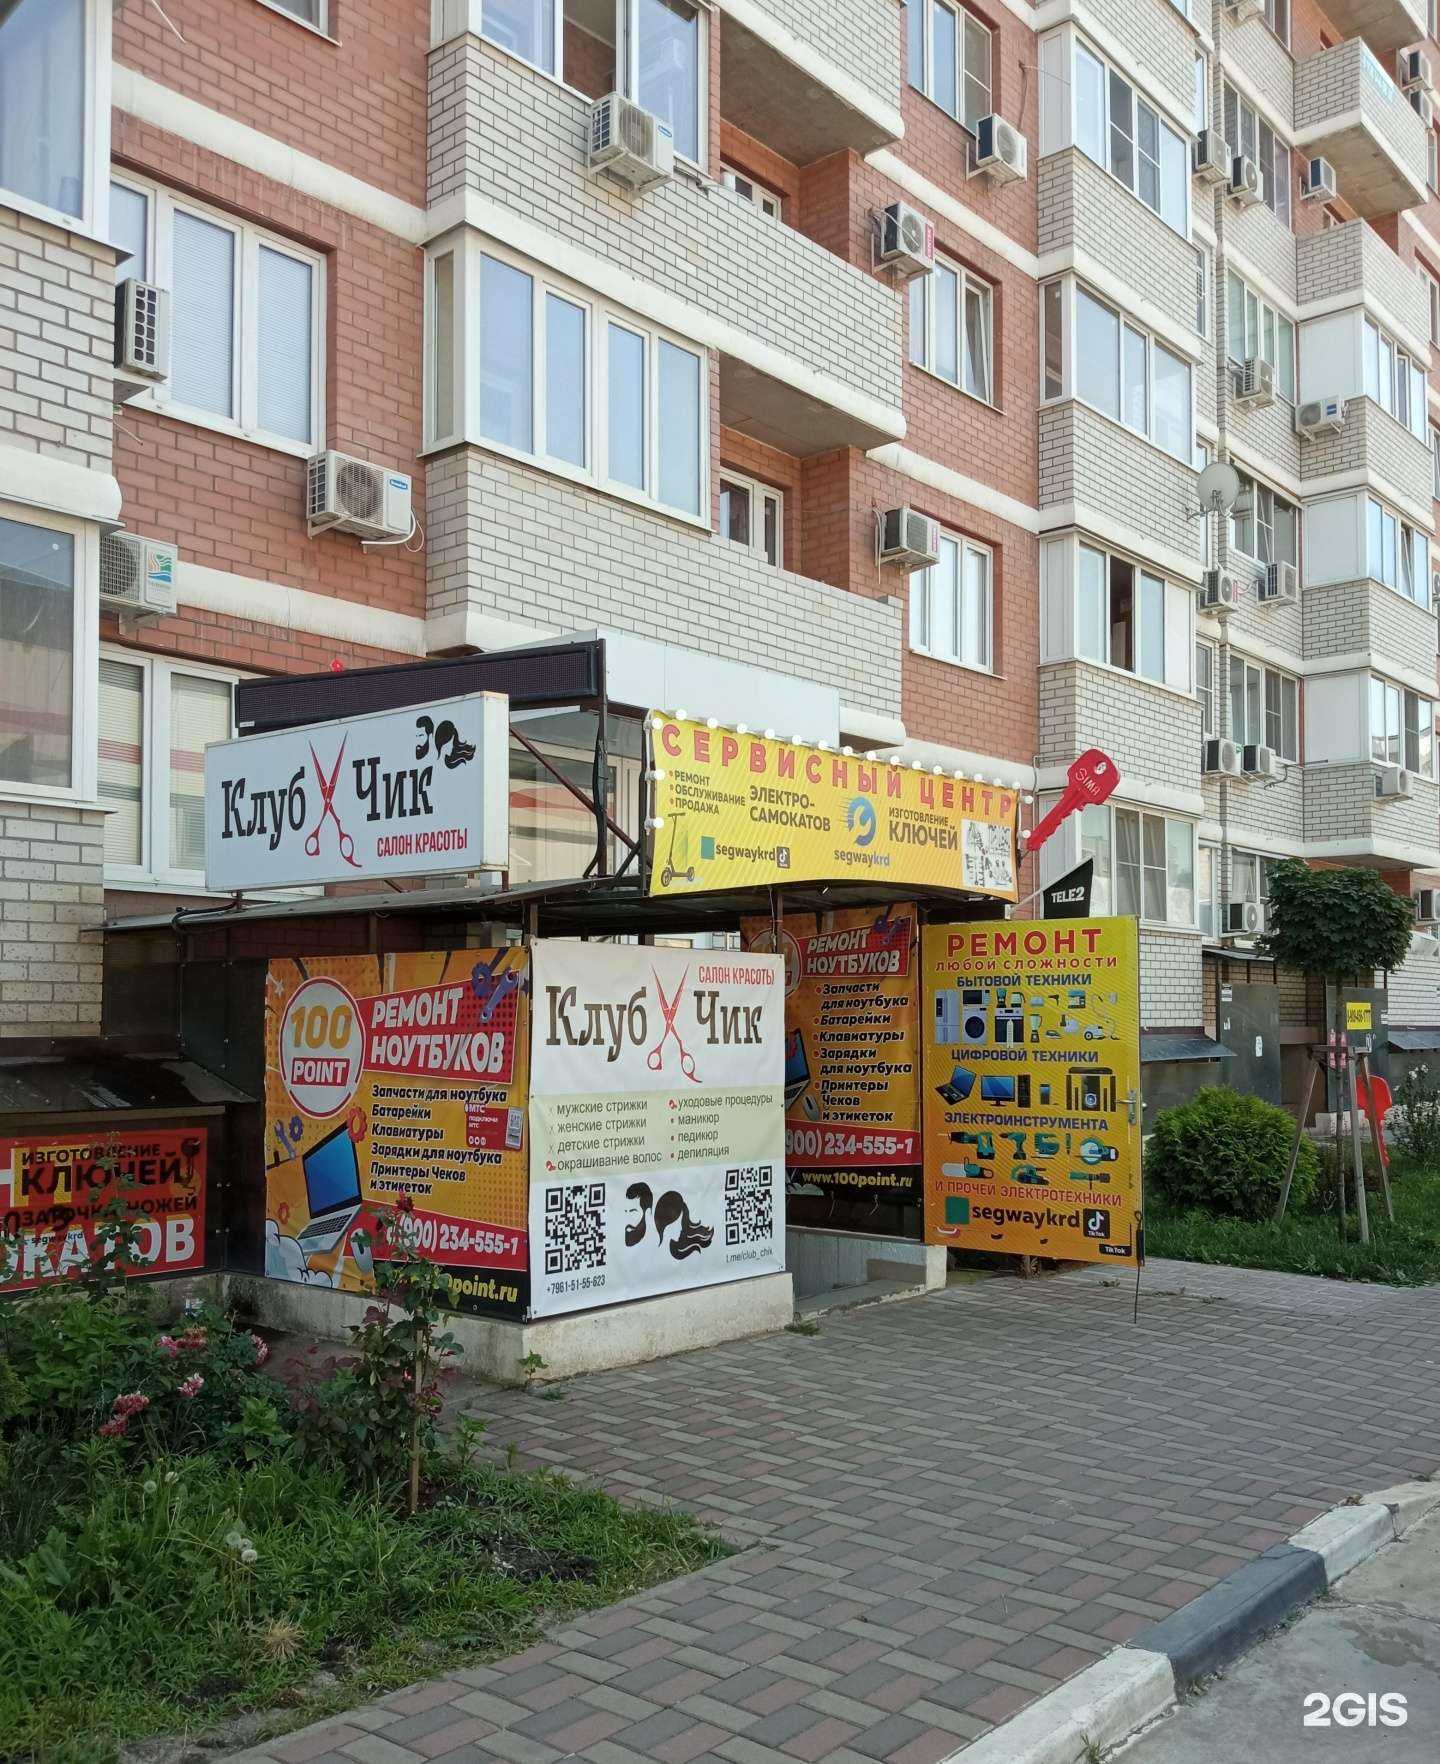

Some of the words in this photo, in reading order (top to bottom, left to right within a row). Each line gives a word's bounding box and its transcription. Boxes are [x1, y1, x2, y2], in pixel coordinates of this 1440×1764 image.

[660, 722, 902, 799] СЕРВИСНЫЙ
[919, 781, 1013, 819] ЦЕНТР
[674, 770, 711, 787] РЕМОНТ
[352, 756, 434, 821] Чик
[674, 785, 746, 807] ОБСЛУЖИВАНИЕ
[748, 784, 816, 810] ЭЛЕКТРО-
[221, 766, 306, 851] Клуб
[674, 796, 720, 816] ПРОДАЖА
[888, 806, 950, 827] ИЗГОТОВЛЕНИЕ
[748, 805, 831, 832] САМОКАТОВ
[377, 833, 412, 857] САЛОН
[414, 828, 468, 854] КРАСОТЫ
[888, 822, 959, 851] КЛЮЧЕЙ
[715, 842, 777, 864] segwaykrd
[833, 847, 891, 868] segwaykrd
[1051, 886, 1085, 904] TELE2
[807, 927, 871, 954] РЕМОНТ
[947, 927, 1102, 958] РЕМОНТ
[806, 949, 901, 974] НОУТБУКОВ
[698, 965, 731, 985] САЛОН
[732, 967, 775, 986] КРАСОТЫ
[956, 972, 1021, 988] БЫТОВОЙ
[1025, 973, 1092, 986] ТЕХНИКИ
[822, 983, 880, 995] Запчасти
[371, 986, 464, 1029] РЕМОНТ
[820, 999, 846, 1012] для
[845, 995, 909, 1010] ноутбука
[291, 1004, 352, 1050] 100
[545, 986, 648, 1063] Клуб
[693, 990, 763, 1045] Чик
[820, 1012, 891, 1027] Батарейки
[819, 1031, 905, 1045] Клавиатуры
[370, 1032, 506, 1074] НОУТБУКОВ
[819, 1048, 877, 1061] Зарядки
[951, 1048, 1027, 1063] ЦИФРОВОЙ
[1032, 1050, 1099, 1063] ТЕХНИКИ
[292, 1059, 347, 1084] POINT
[820, 1063, 844, 1076] для
[845, 1062, 913, 1075] ноутбука
[371, 1084, 426, 1100] Запчасти
[425, 1086, 448, 1101] для
[450, 1086, 508, 1104] ноутбука
[820, 1079, 889, 1092] Принтеры
[556, 1102, 604, 1116] мужские
[606, 1099, 648, 1116] стрижки
[677, 1096, 723, 1110] уходовые
[724, 1093, 774, 1108] процедуры
[821, 1094, 861, 1106] Чеков
[371, 1103, 432, 1122] Батарейки
[677, 1113, 720, 1128] маникюр
[832, 1111, 894, 1122] этикеток
[944, 1111, 1109, 1132] ЭЛЕКТРОИНСТРУМЕНТА
[371, 1122, 445, 1142] Клавиатуры
[556, 1120, 603, 1134] женские
[605, 1117, 647, 1134] стрижки
[557, 1137, 600, 1155] детские
[603, 1135, 645, 1152] стрижки
[677, 1130, 719, 1145] педикюр
[824, 1131, 914, 1156] 234-555-1
[370, 1141, 420, 1159] Зарядки
[421, 1146, 445, 1161] для
[446, 1149, 502, 1166] ноутбука
[557, 1154, 630, 1173] окрашивание
[632, 1151, 663, 1165] волос
[677, 1146, 730, 1162] депиляция
[370, 1160, 430, 1179] Принтеры
[431, 1166, 466, 1182] Чеков
[802, 1171, 913, 1189] www.100point.ru
[370, 1178, 378, 1190] и
[378, 1181, 433, 1195] этикеток
[935, 1182, 945, 1192] И
[947, 1180, 996, 1196] ПРОЧЕЙ
[1000, 1185, 1122, 1207] ЭЛЕКТРОТЕХНИКИ
[971, 1205, 1080, 1229] segwaykrd
[439, 1223, 519, 1256] 234-555-1
